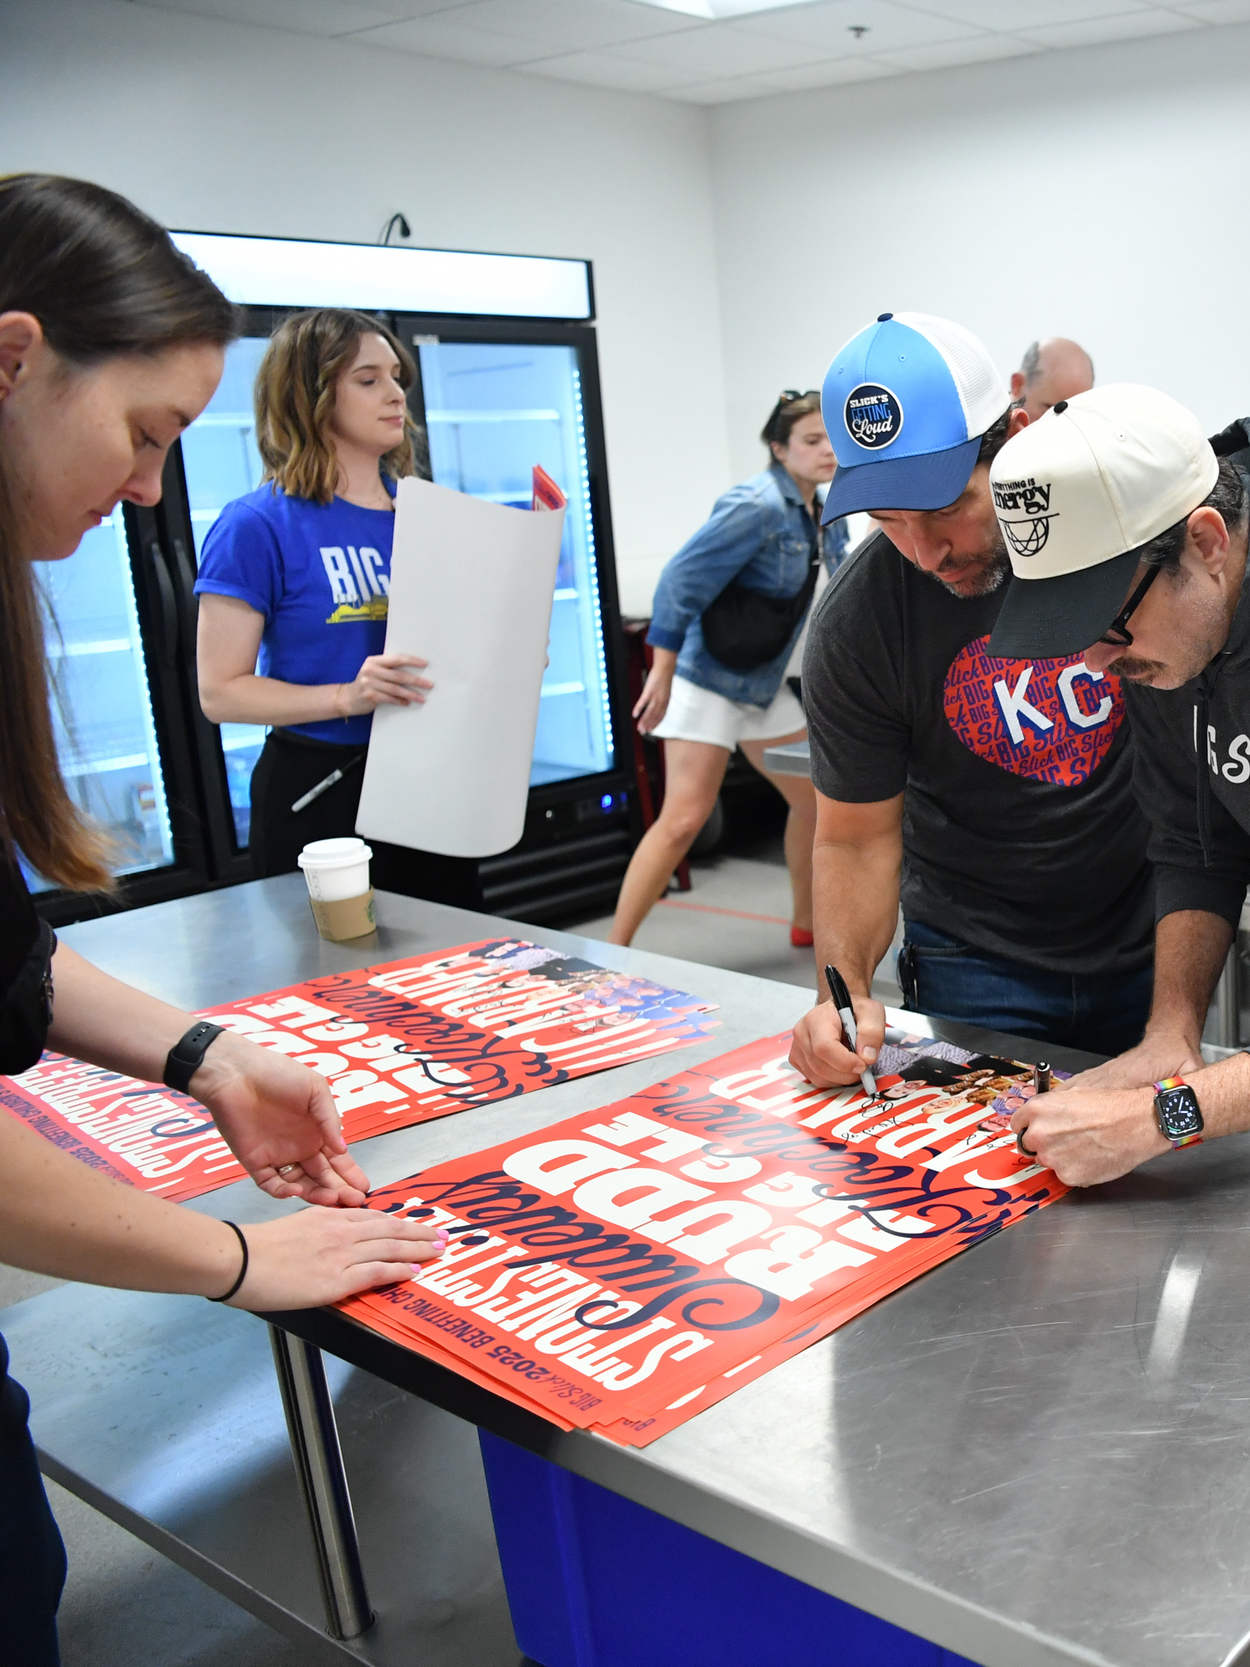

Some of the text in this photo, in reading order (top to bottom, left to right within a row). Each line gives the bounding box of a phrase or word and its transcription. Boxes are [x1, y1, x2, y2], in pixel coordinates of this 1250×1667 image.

[850, 394, 889, 408] SLICK'S
[852, 415, 893, 443] Loud
[995, 483, 1051, 515] nergy
[320, 546, 391, 604] BIG
[994, 662, 1113, 745] KC
[246, 995, 472, 1094] RIGGLE
[581, 1112, 936, 1253] RIGGLE
[502, 1139, 878, 1302] RUDD
[402, 1293, 496, 1349] BENEFITING
[485, 1344, 551, 1382] 2025
[575, 1389, 603, 1412] BIG
